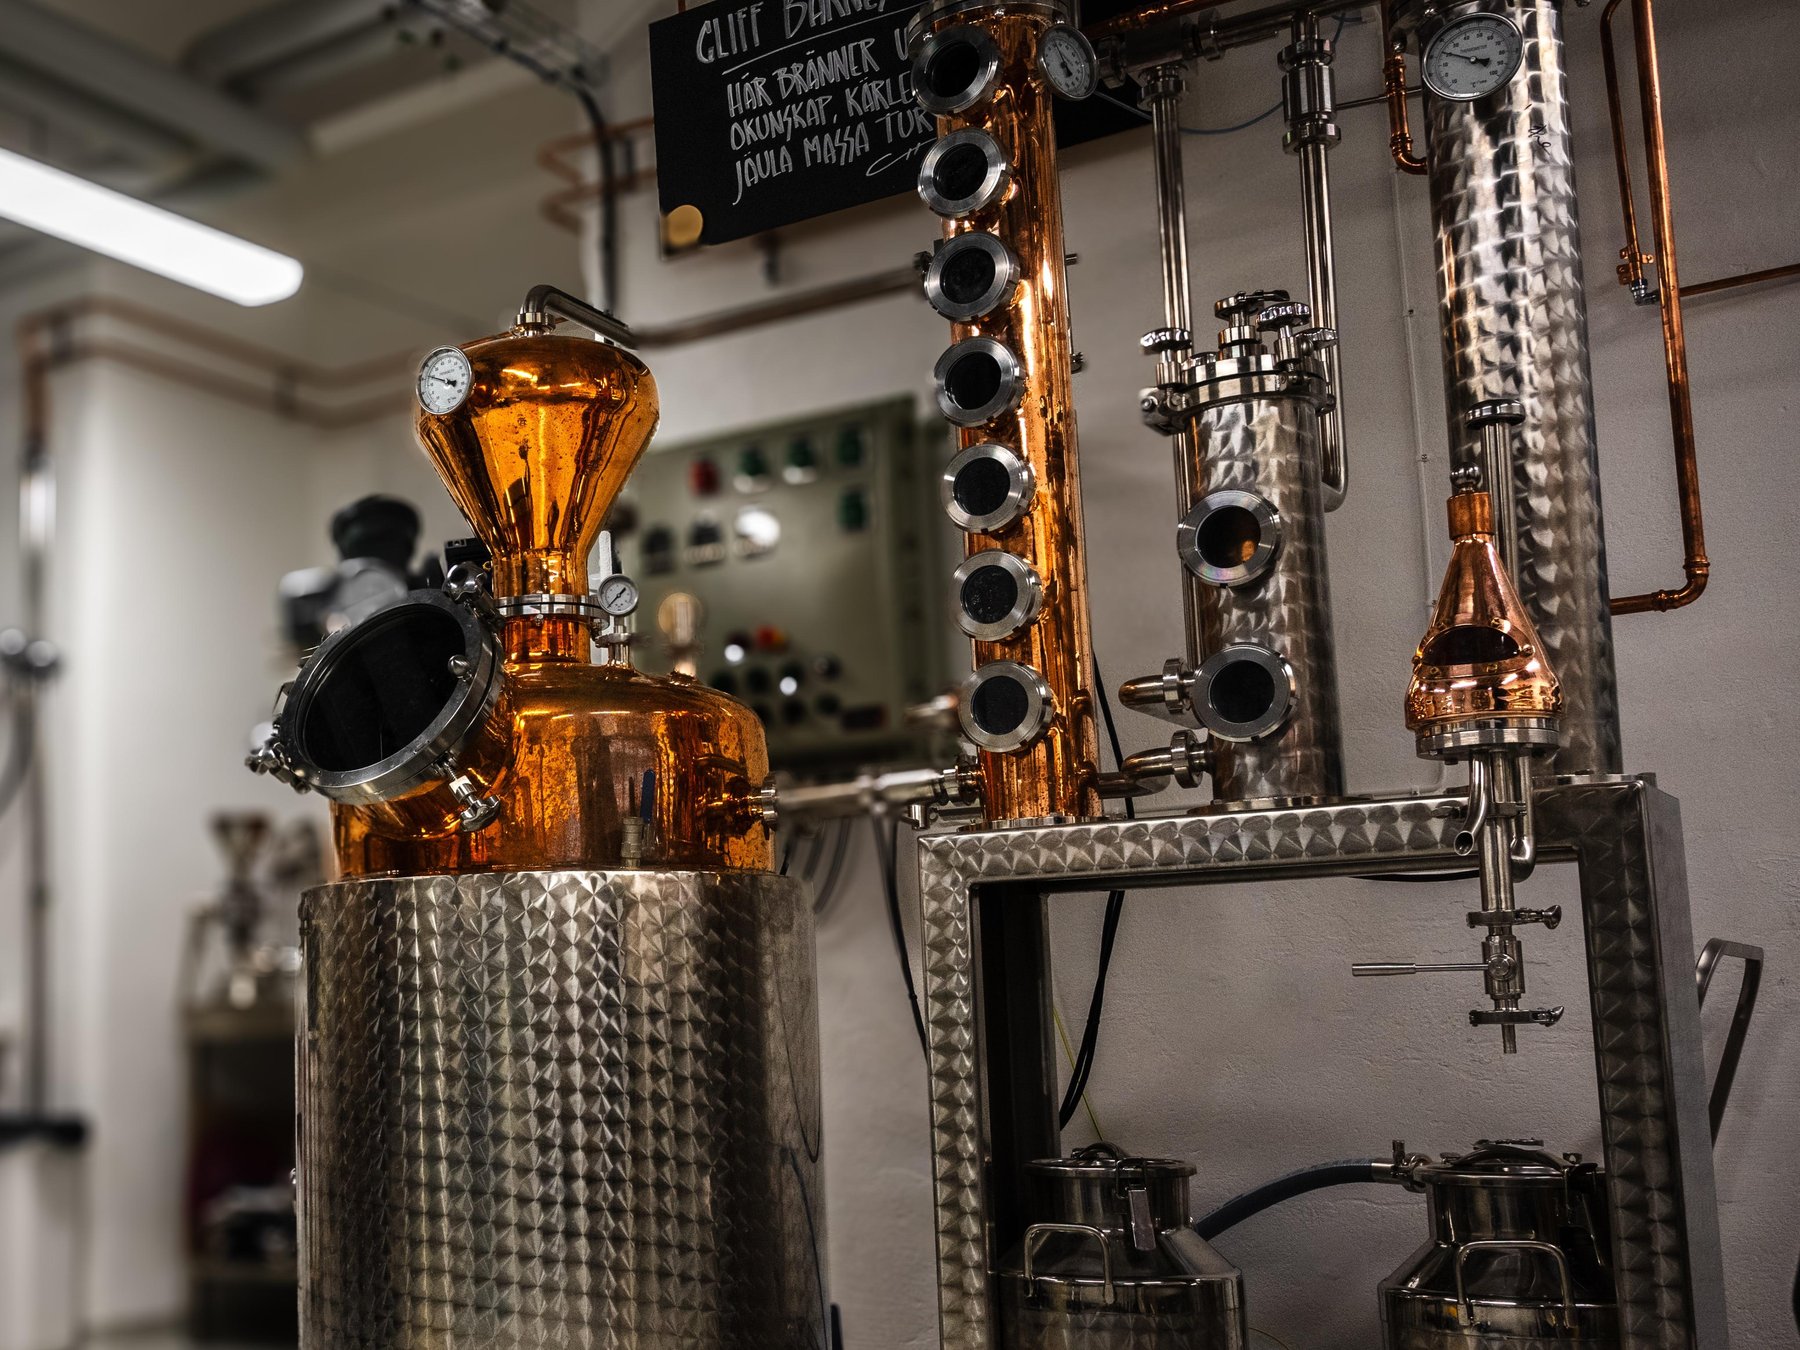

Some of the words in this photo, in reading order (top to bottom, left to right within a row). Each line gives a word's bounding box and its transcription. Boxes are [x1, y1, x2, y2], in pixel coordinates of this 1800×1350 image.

[696, 1, 764, 64] CLIFF
[726, 72, 773, 118] HÄR
[771, 37, 880, 100] BRÄNNER
[730, 95, 838, 151] OKUNSKAP,
[844, 71, 914, 117] KÄRLE
[803, 121, 870, 167] MASSA
[874, 106, 934, 144] TUR
